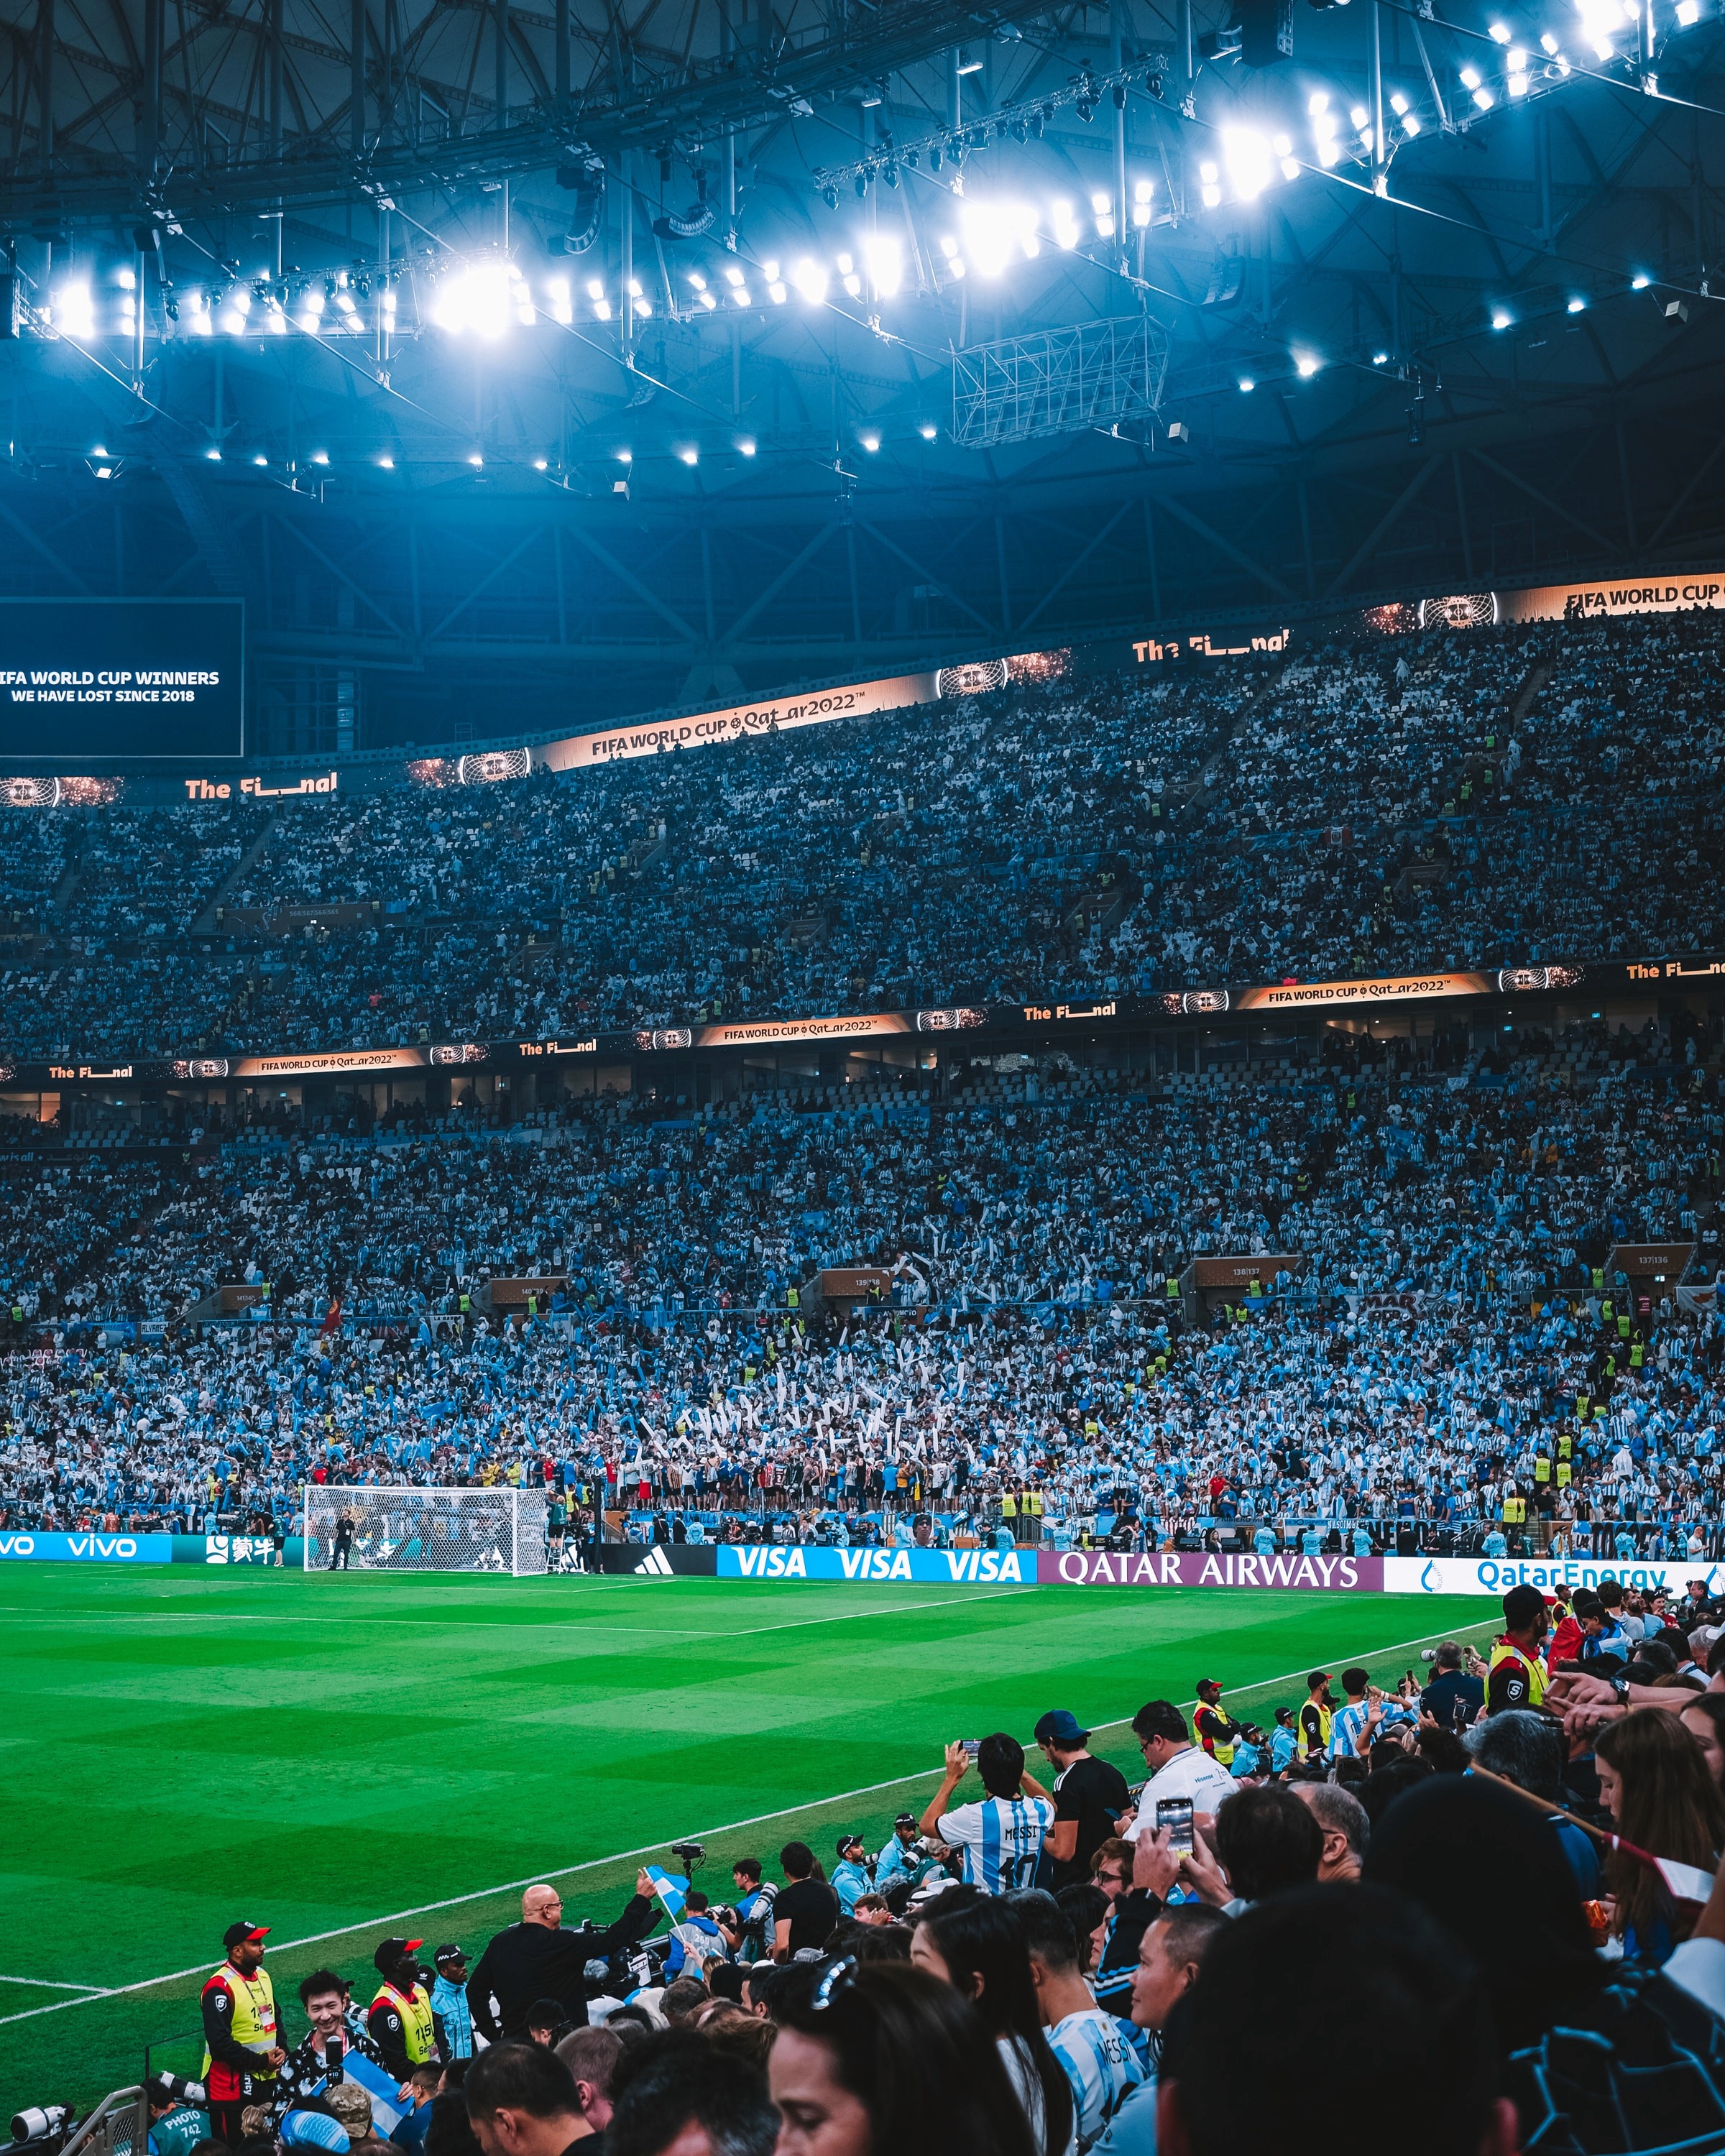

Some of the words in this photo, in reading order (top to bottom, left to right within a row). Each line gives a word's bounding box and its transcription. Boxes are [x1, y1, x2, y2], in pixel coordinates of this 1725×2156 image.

[1567, 592, 1607, 608] FIFA
[1609, 587, 1678, 605] WORLD
[1683, 584, 1719, 600] CUP
[30, 671, 93, 685] WORLD
[98, 671, 132, 686] CUP
[135, 671, 219, 685] WINNERS
[12, 691, 34, 701] WE
[37, 691, 75, 701] HAVE
[78, 691, 112, 702] LOST
[115, 691, 159, 701] SINCE
[162, 691, 195, 702] 2018
[592, 738, 627, 755] FIFA
[630, 727, 691, 748] WORLD
[695, 719, 727, 737] CUP
[185, 779, 230, 799] The
[1627, 964, 1660, 979] The
[1269, 992, 1292, 1002] FIFA
[1294, 990, 1334, 1000] WORLD
[1336, 987, 1357, 998] CUP
[1024, 1007, 1051, 1021] The
[724, 1031, 744, 1040] FIFA
[745, 1028, 779, 1038] WORLD
[781, 1026, 799, 1036] CUP
[519, 1044, 542, 1056] The
[49, 1067, 75, 1078] The
[262, 1062, 279, 1071] FIFA
[280, 1061, 310, 1069] WORLD
[312, 1059, 328, 1068] CUP
[1359, 1294, 1417, 1314] MAR
[67, 1533, 137, 1557] vivo
[232, 1537, 275, 1565] 蒙牛
[730, 1547, 807, 1577] VISA
[833, 1548, 912, 1580] VISA
[940, 1550, 1022, 1582] VISA
[1059, 1551, 1183, 1585] QATAR
[1199, 1554, 1358, 1588] AIRWAYS
[1478, 1561, 1666, 1592] QatarEnergy
[1195, 1774, 1214, 1784] Hisense
[1004, 1825, 1037, 1841] MESSI
[694, 1934, 709, 1946] 260
[1097, 2037, 1131, 2066] MESSI
[165, 2109, 201, 2130] PHOTO
[180, 2124, 202, 2137] 742
